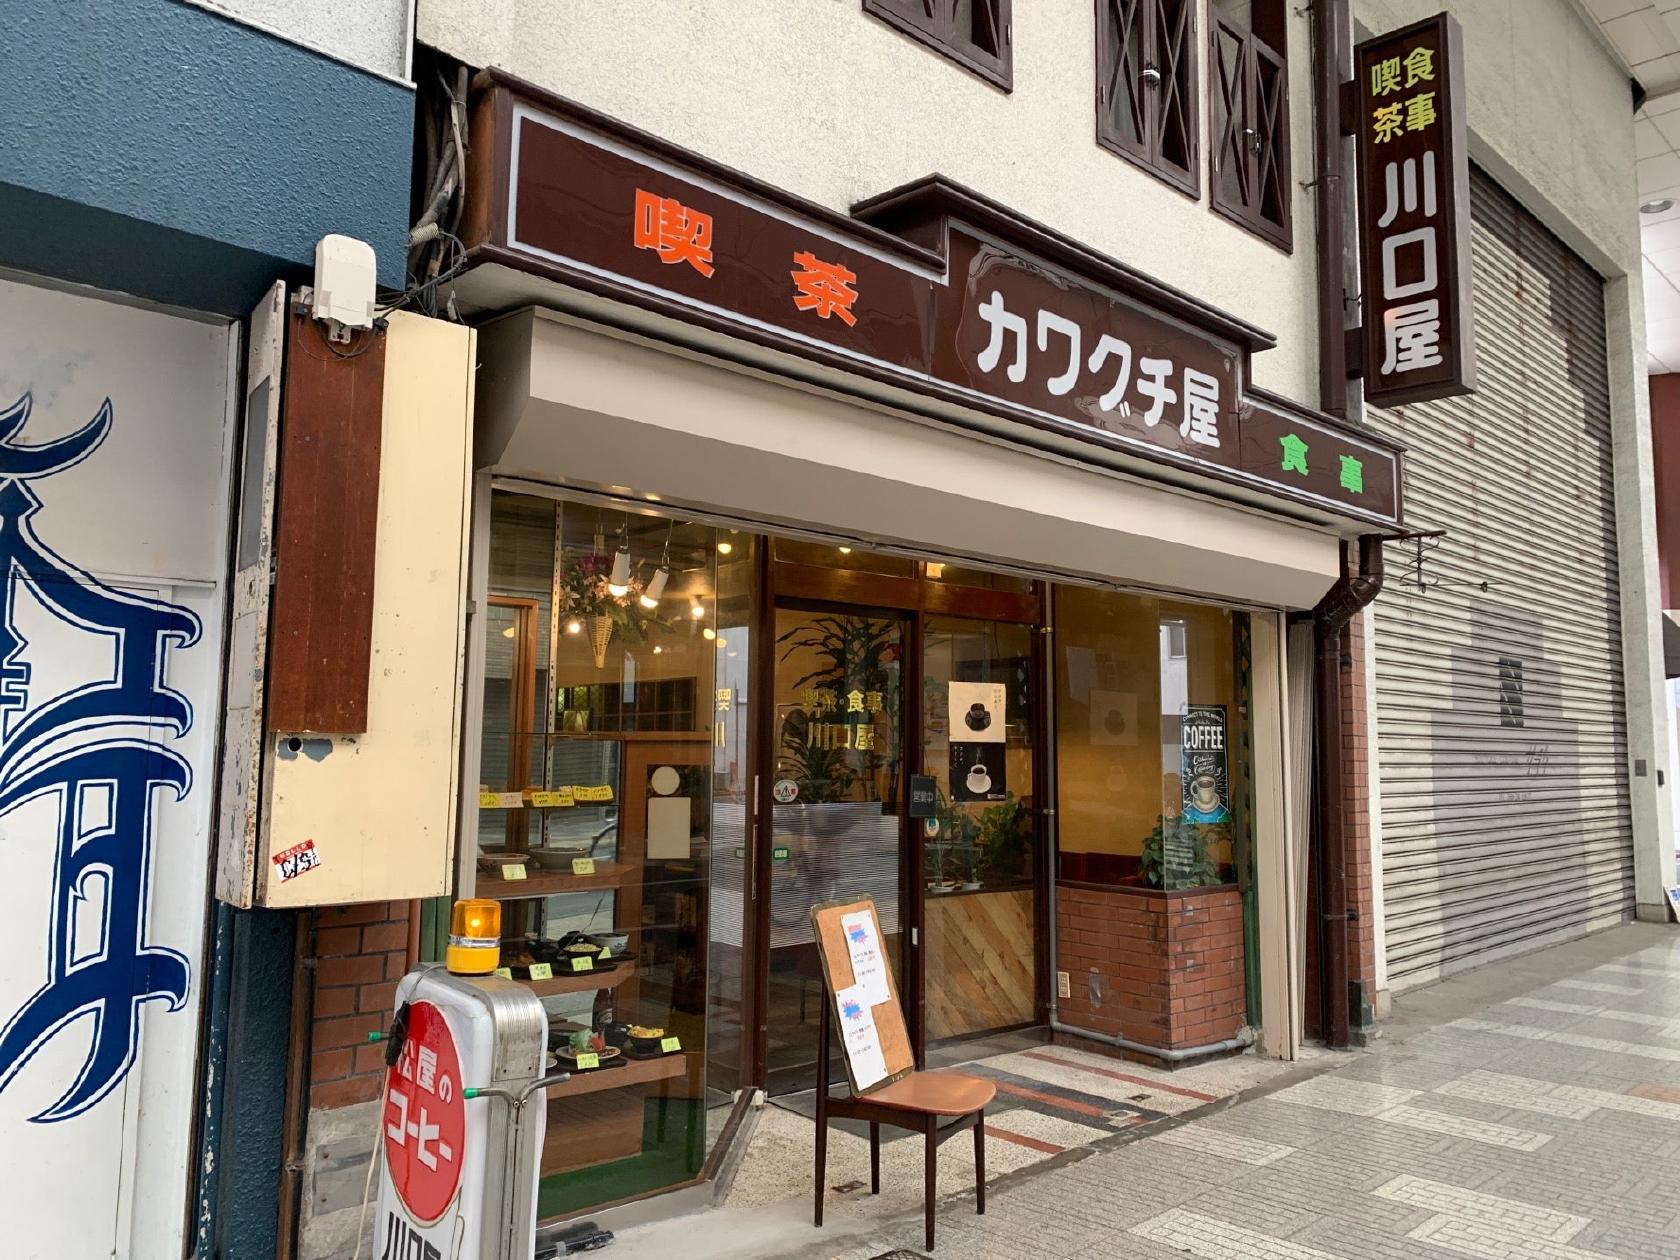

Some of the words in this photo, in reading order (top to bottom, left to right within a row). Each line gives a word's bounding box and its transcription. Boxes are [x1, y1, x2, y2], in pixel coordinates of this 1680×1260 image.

[633, 187, 859, 327] 喫茶
[1377, 150, 1443, 376] 川口屋
[977, 290, 1221, 448] カワグチ屋
[1279, 433, 1363, 495] 食事
[1183, 725, 1224, 750] COFFEE
[387, 1087, 453, 1173] コーヒー
